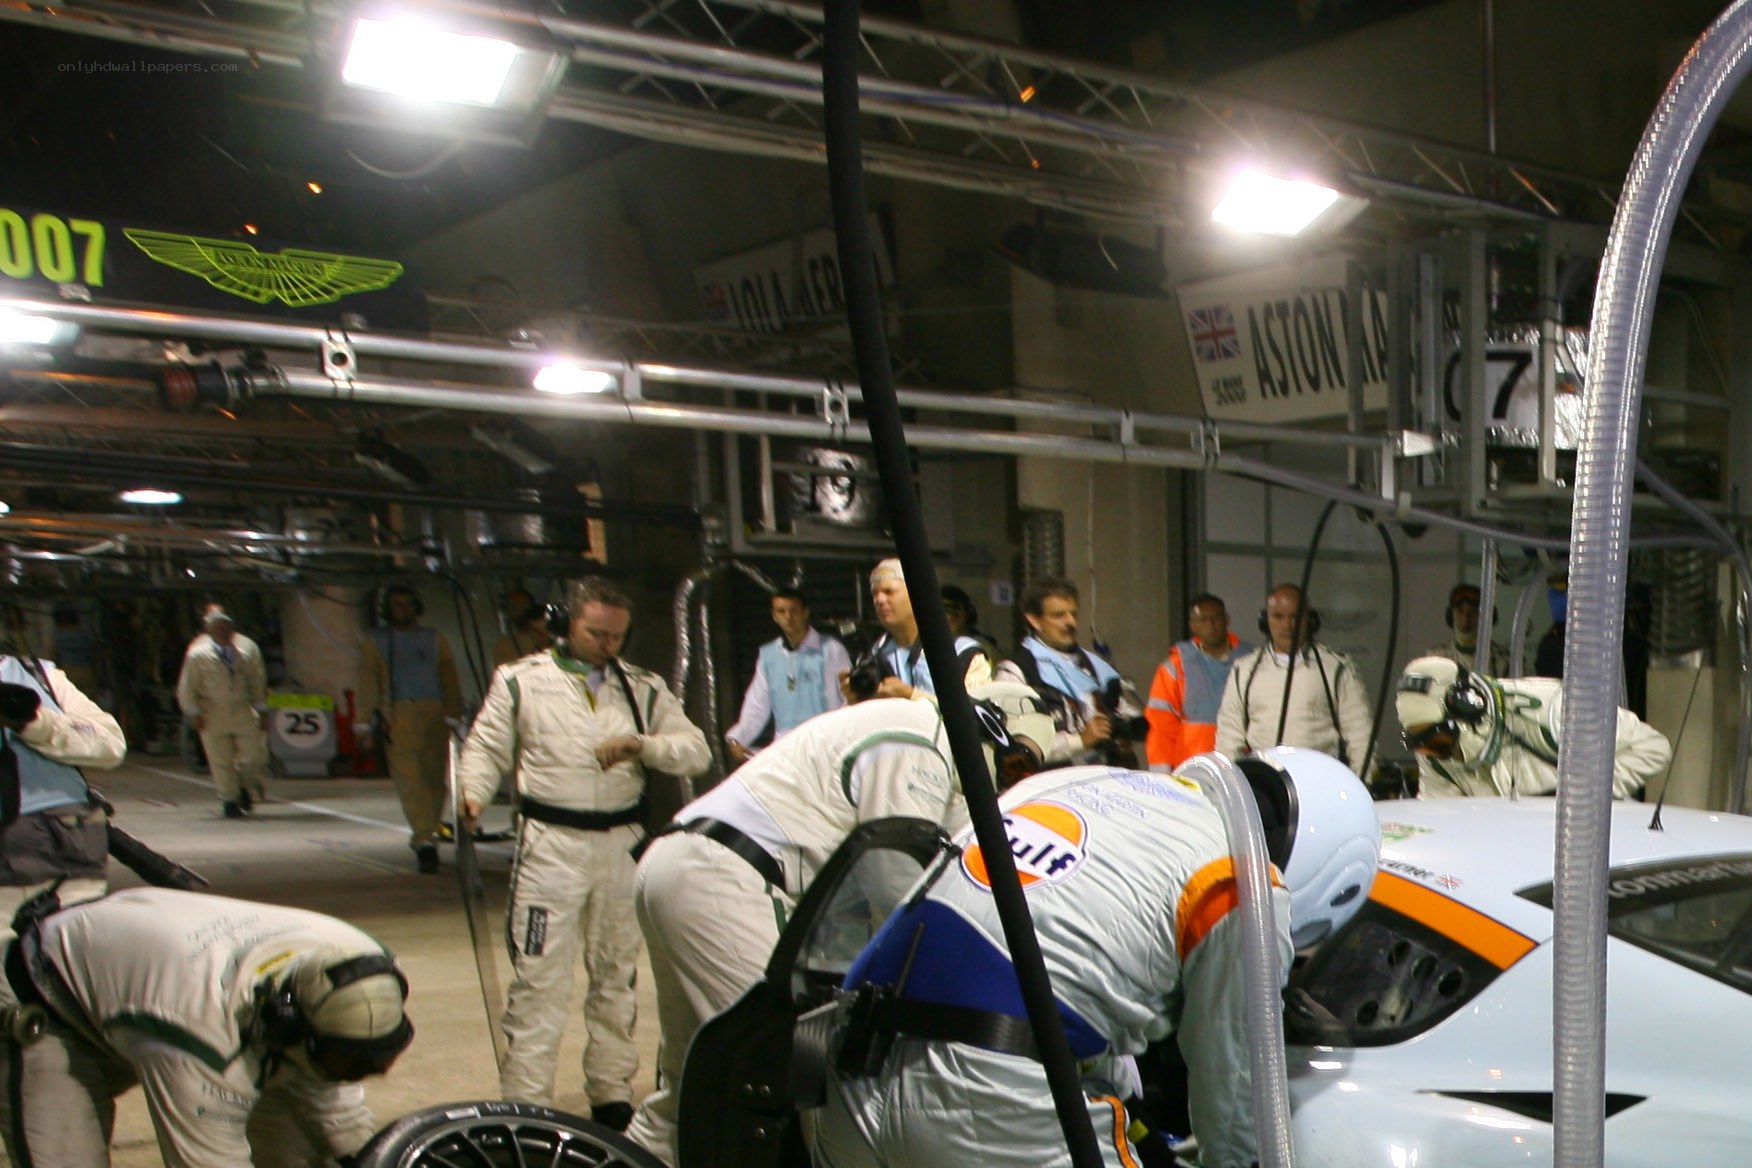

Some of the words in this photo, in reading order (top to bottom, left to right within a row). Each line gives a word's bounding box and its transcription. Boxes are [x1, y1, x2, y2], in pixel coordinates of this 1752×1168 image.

[0, 208, 106, 288] 007
[1247, 292, 1347, 399] ASTON
[284, 711, 320, 736] 25
[1001, 816, 1067, 875] ulf
